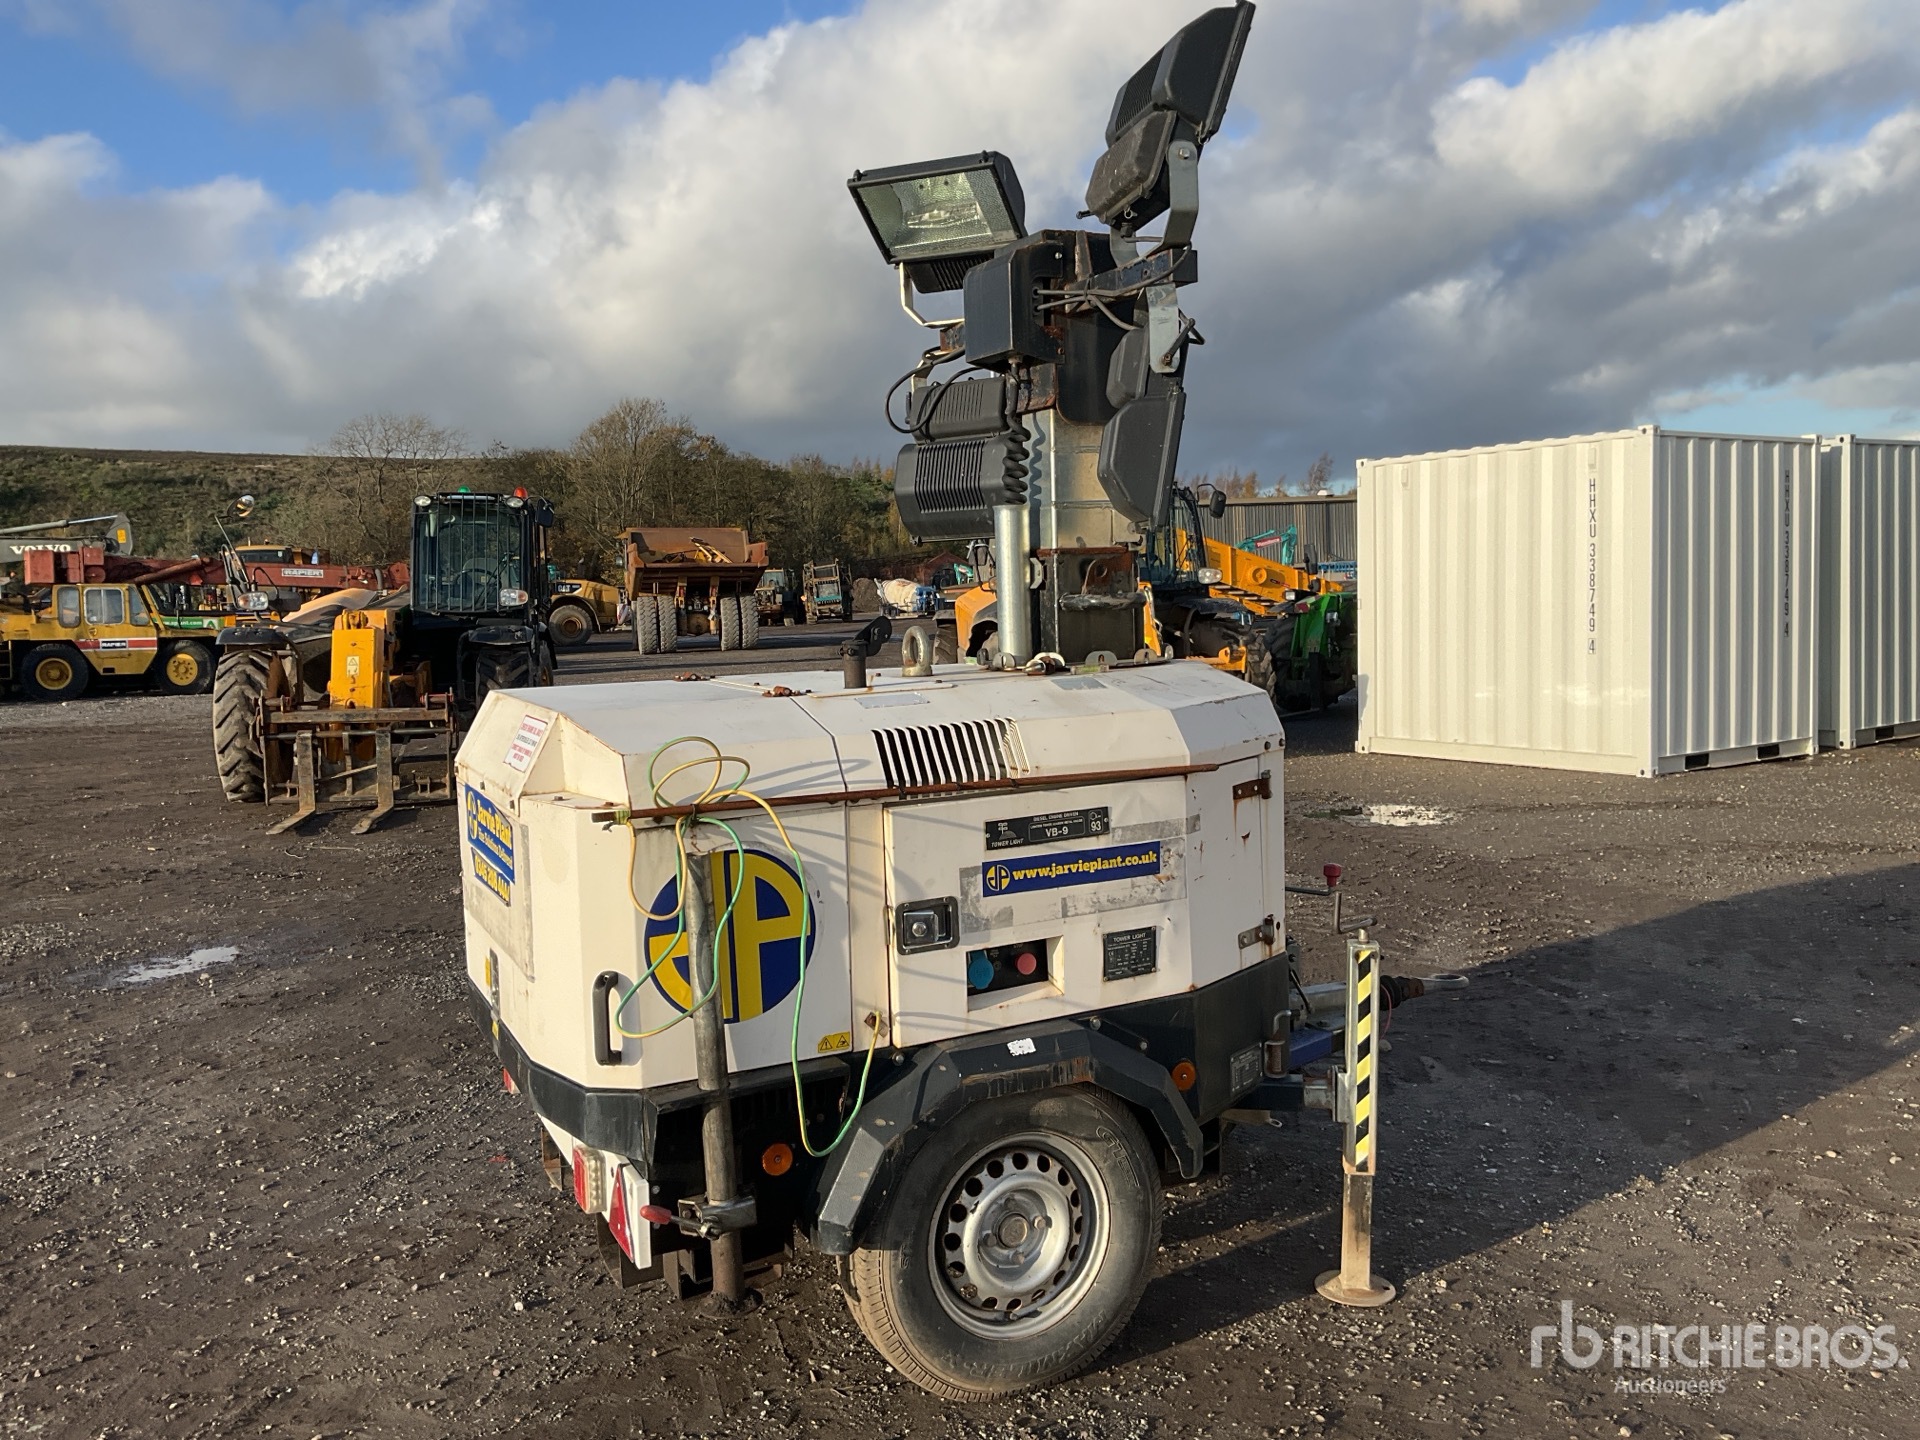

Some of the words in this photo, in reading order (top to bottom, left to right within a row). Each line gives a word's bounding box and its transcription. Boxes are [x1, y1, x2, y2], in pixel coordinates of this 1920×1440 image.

[1589, 478, 1597, 538] HHXU
[9, 544, 71, 554] VOLVO
[558, 584, 570, 592] CAT
[1589, 639, 1595, 654] 4
[1045, 826, 1068, 837] VB-9
[1090, 821, 1102, 832] 93
[991, 840, 1010, 848] TOWER
[1010, 838, 1024, 846] LIGHT
[1012, 851, 1157, 880] www.jarvieplant.co.uk
[1131, 932, 1146, 940] LIGHT
